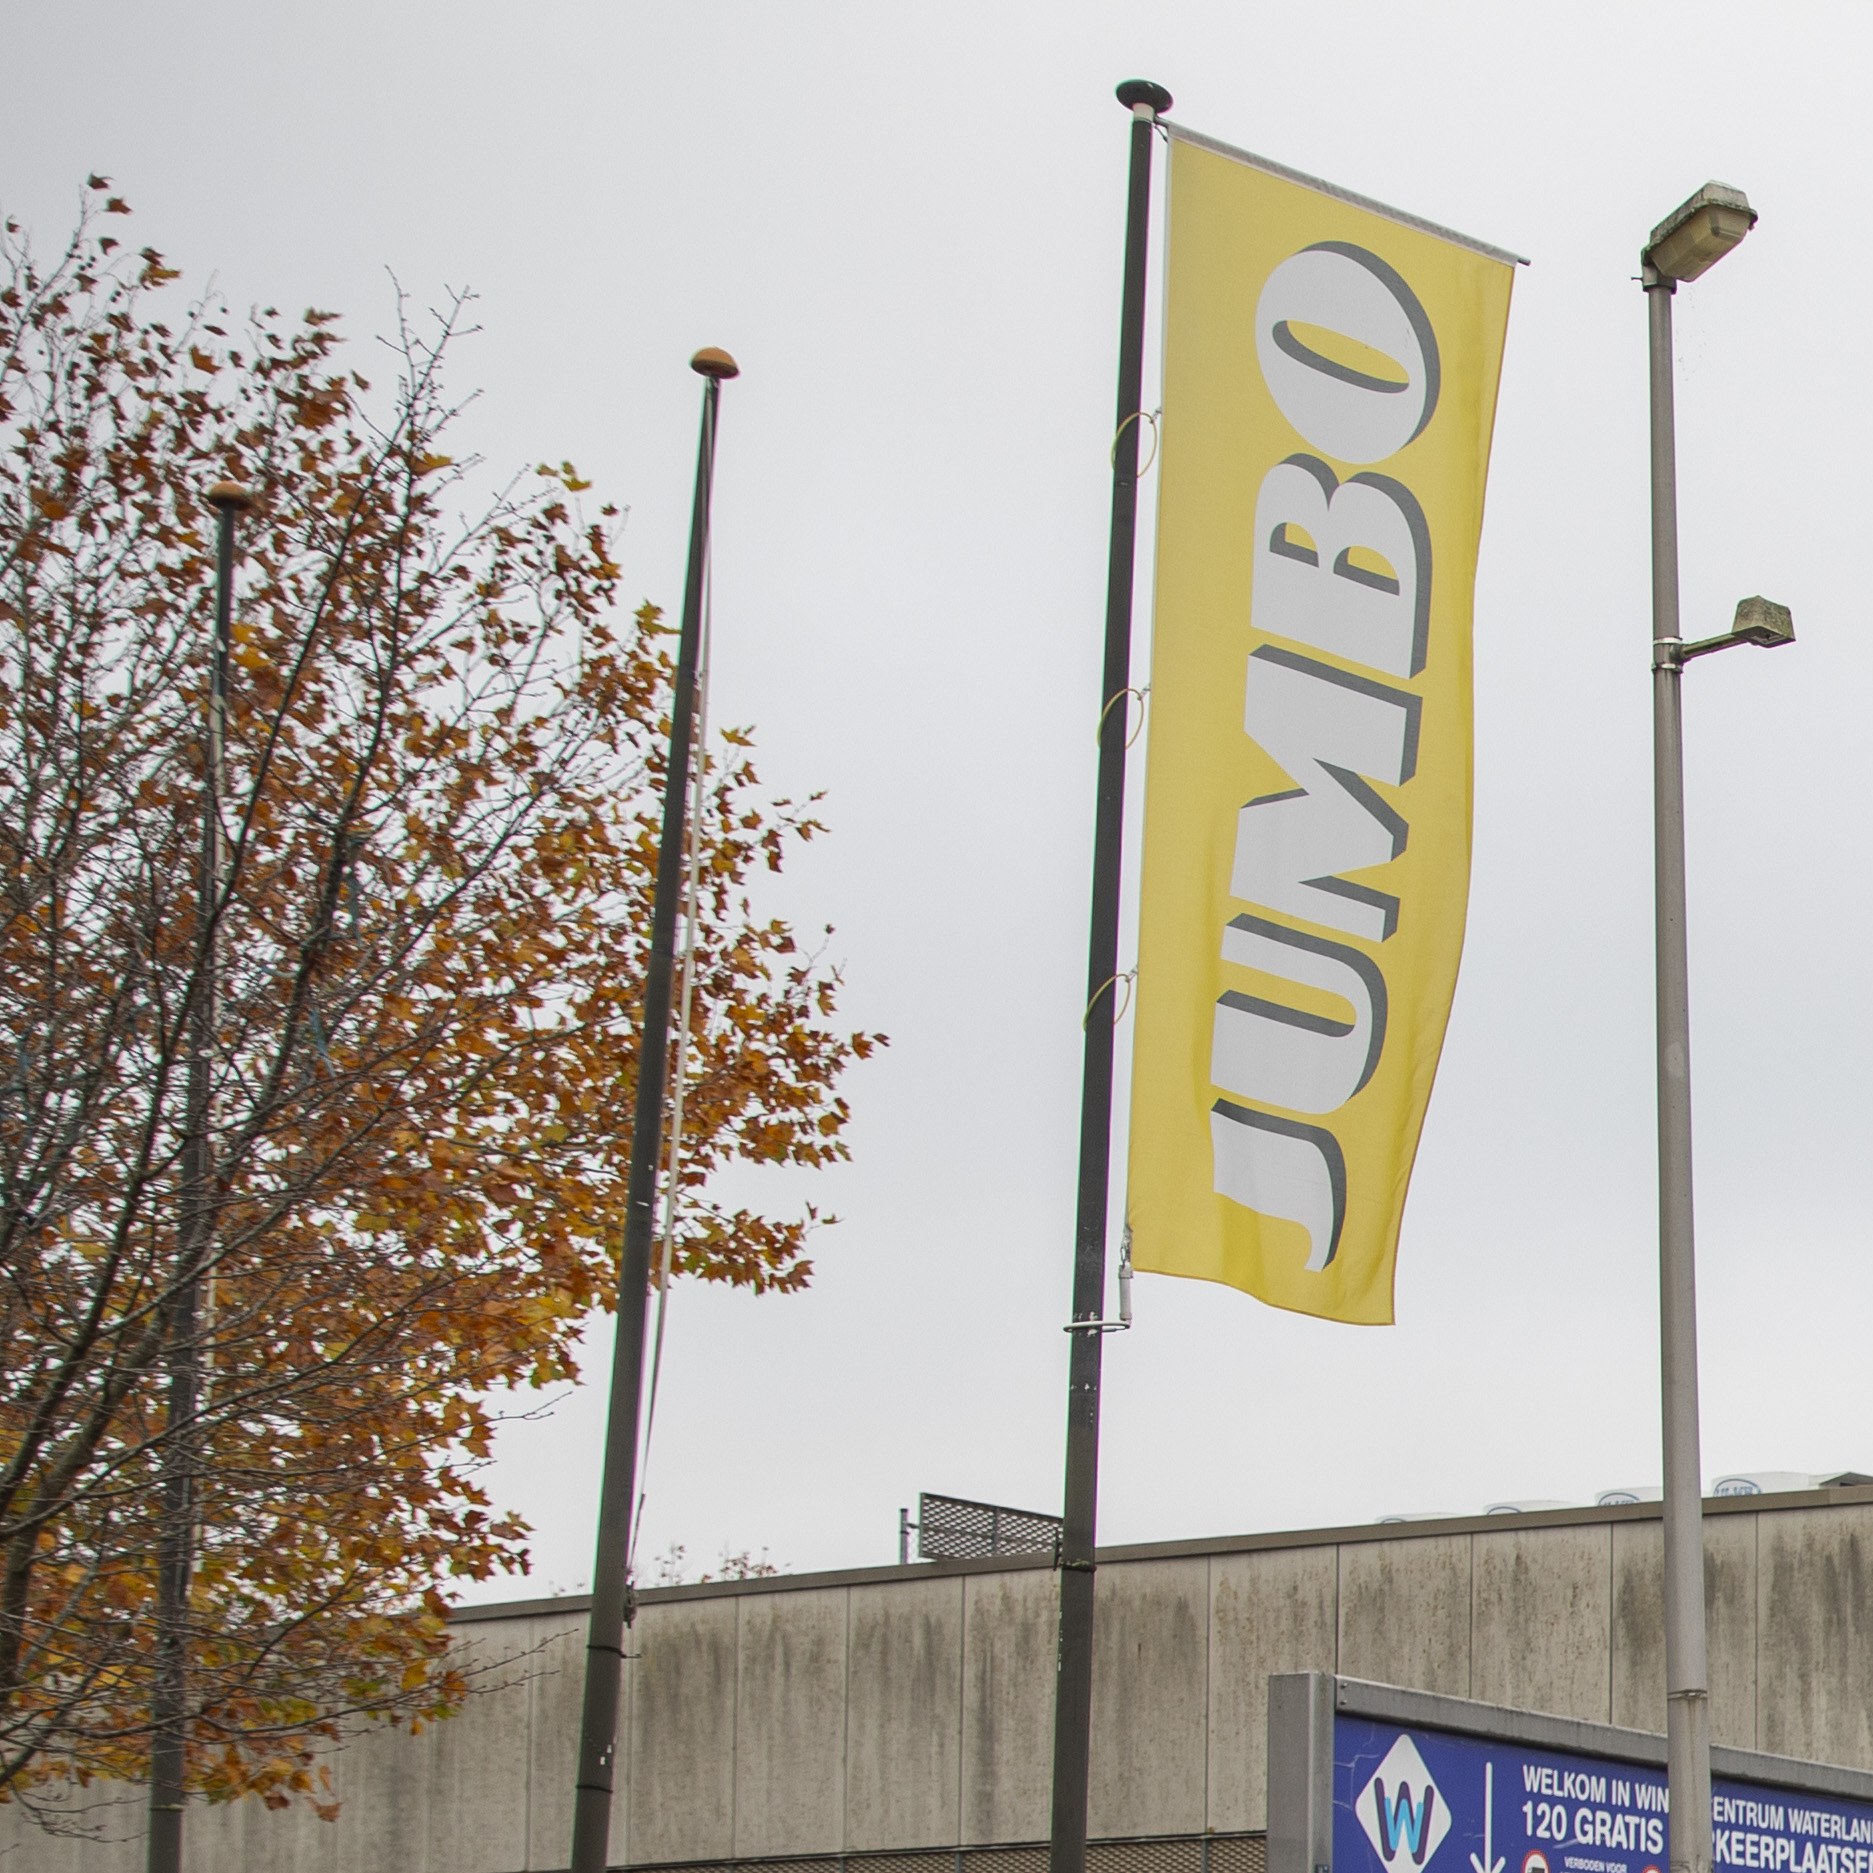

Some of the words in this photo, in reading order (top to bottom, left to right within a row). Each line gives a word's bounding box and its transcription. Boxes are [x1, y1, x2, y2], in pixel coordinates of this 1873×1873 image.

[1210, 240, 1442, 1273] JUMBO
[1522, 1764, 1606, 1804] WELKOM
[1611, 1779, 1630, 1808] IN
[1635, 1783, 1784, 1831] WINENTRUM
[1522, 1800, 1567, 1841] 120
[1574, 1807, 1664, 1855] GRATIS
[1564, 1856, 1605, 1873] VERBODEN
